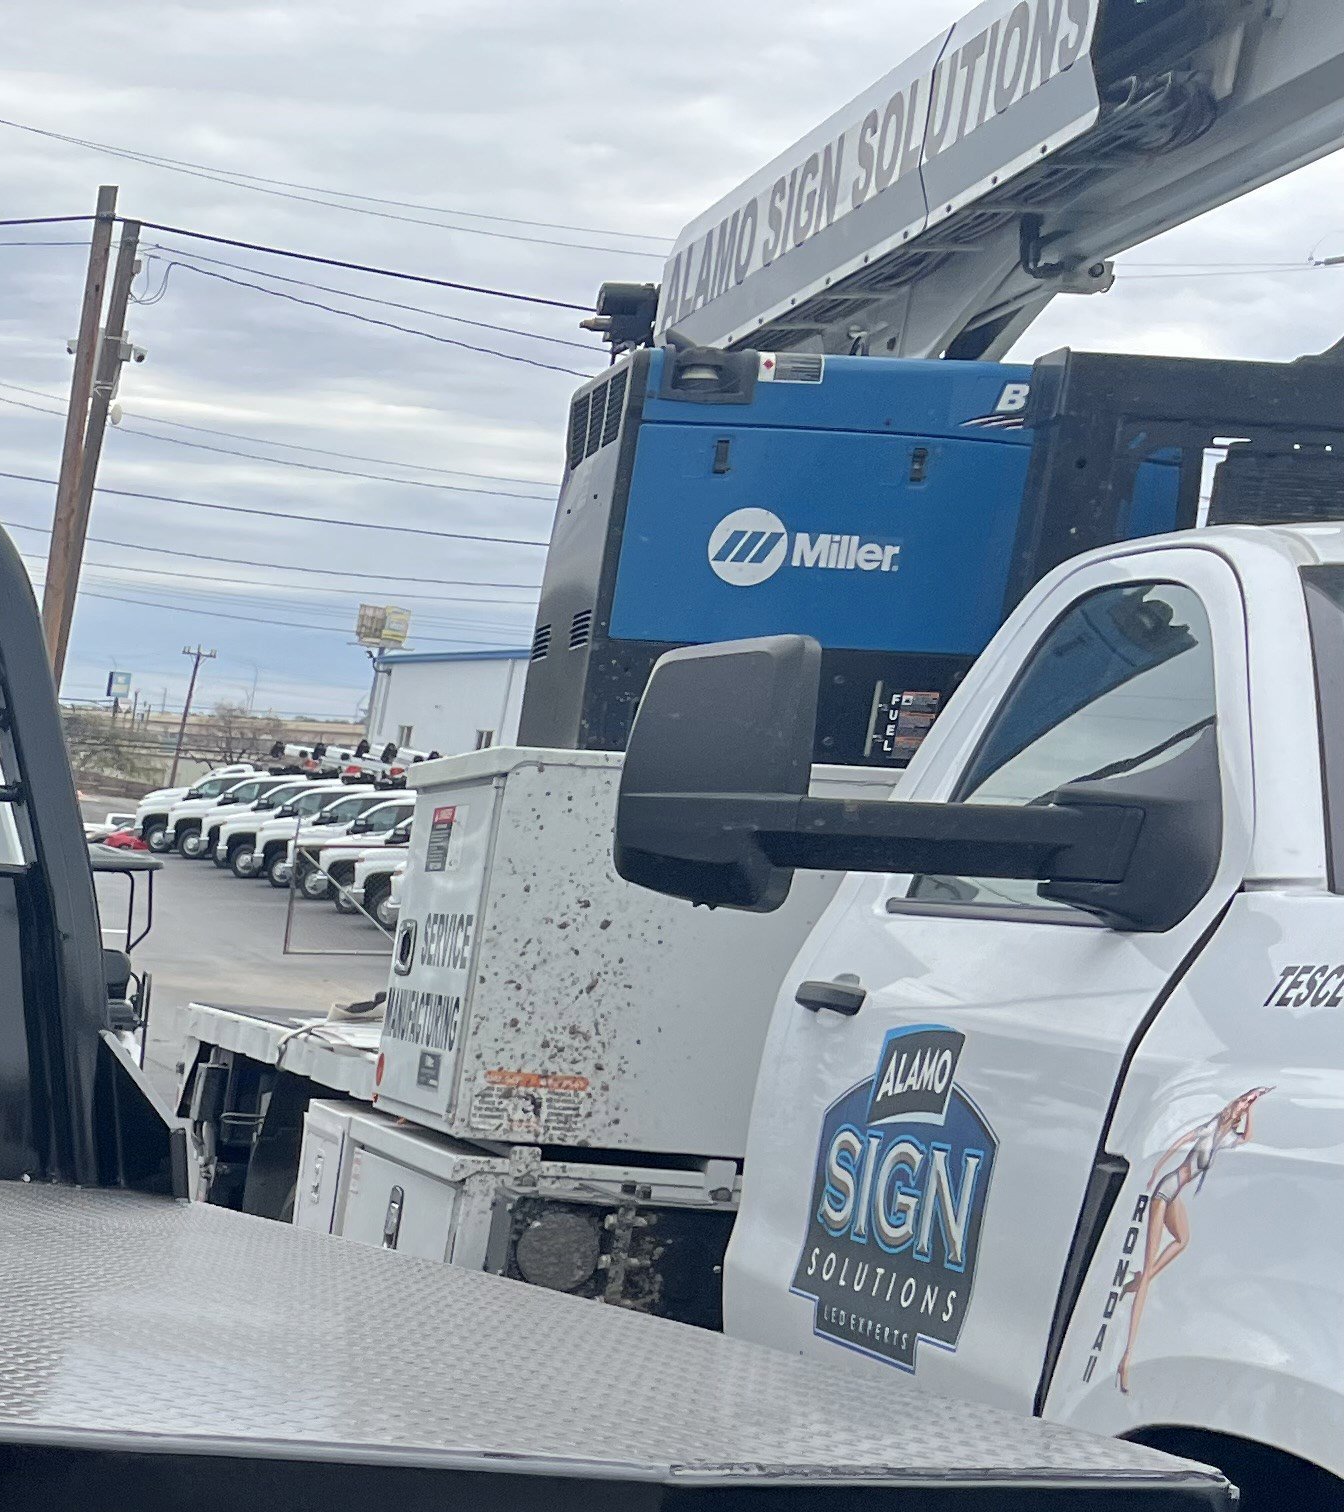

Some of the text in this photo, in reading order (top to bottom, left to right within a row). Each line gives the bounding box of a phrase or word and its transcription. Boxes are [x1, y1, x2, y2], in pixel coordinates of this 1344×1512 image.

[661, 0, 1090, 328] ALAMO SIGN SOLUTIONS
[883, 694, 901, 752] FUEL
[420, 912, 473, 970] SERVICE
[382, 986, 460, 1052] MANUFACTURING
[875, 1047, 953, 1102] ALAMO
[817, 1123, 984, 1273] SIGN
[808, 1247, 957, 1323] SOLUTIONS
[824, 1306, 909, 1351] LED EXPERTS
